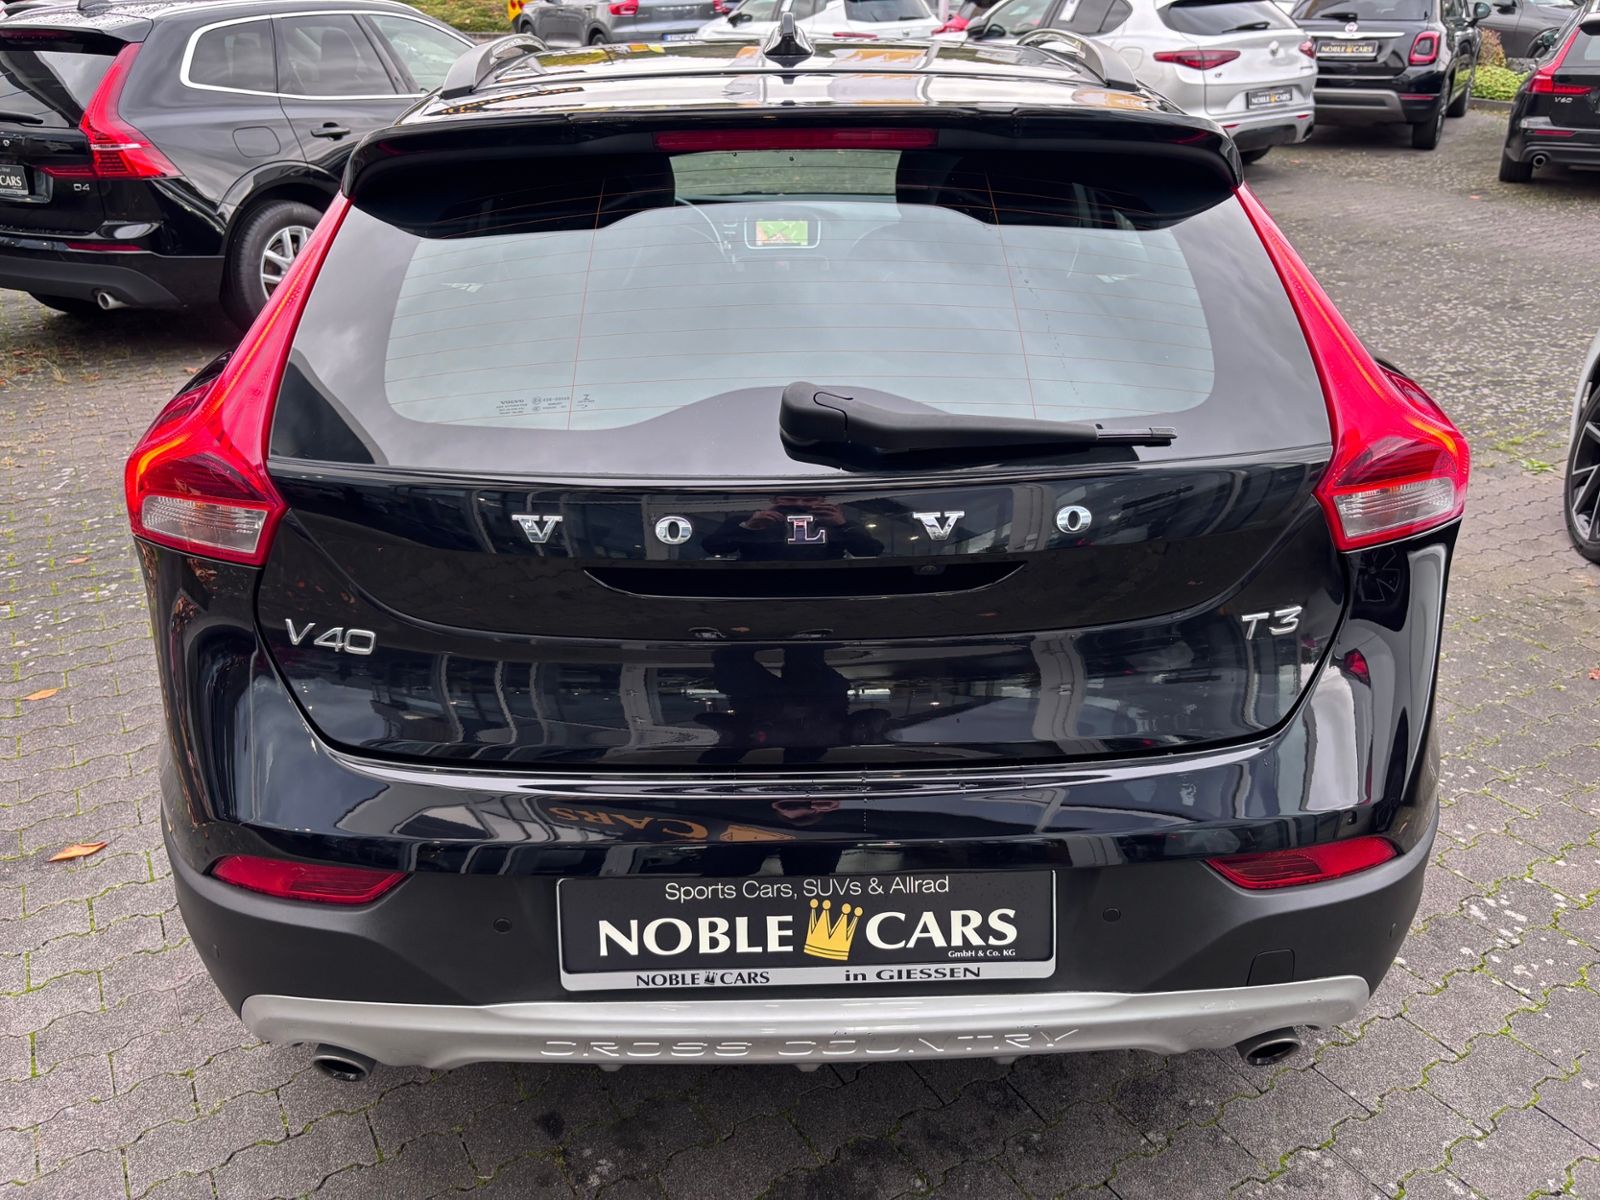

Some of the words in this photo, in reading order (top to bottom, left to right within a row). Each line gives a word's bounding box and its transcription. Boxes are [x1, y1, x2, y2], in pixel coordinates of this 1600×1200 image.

[73, 183, 90, 191] D4
[511, 504, 1092, 544] VOLVO
[284, 618, 376, 655] V40
[1241, 605, 1303, 640] T3
[665, 882, 737, 904] Sports
[742, 880, 798, 900] Cars,
[803, 877, 862, 896] SUVs
[868, 877, 884, 895] &
[890, 875, 949, 894] Allrad
[598, 915, 794, 957] NOBLE
[865, 908, 1018, 950] CARS
[948, 949, 975, 958] GmbH
[978, 949, 985, 957] &
[987, 949, 1000, 957] Co.
[1003, 949, 1016, 957] KG
[636, 973, 700, 987] NOBLE
[720, 971, 770, 985] CARS
[845, 970, 867, 982] in
[875, 966, 981, 981] GIESSEN
[540, 1040, 753, 1056] CROSS
[778, 1029, 1079, 1055] COUNTRY
